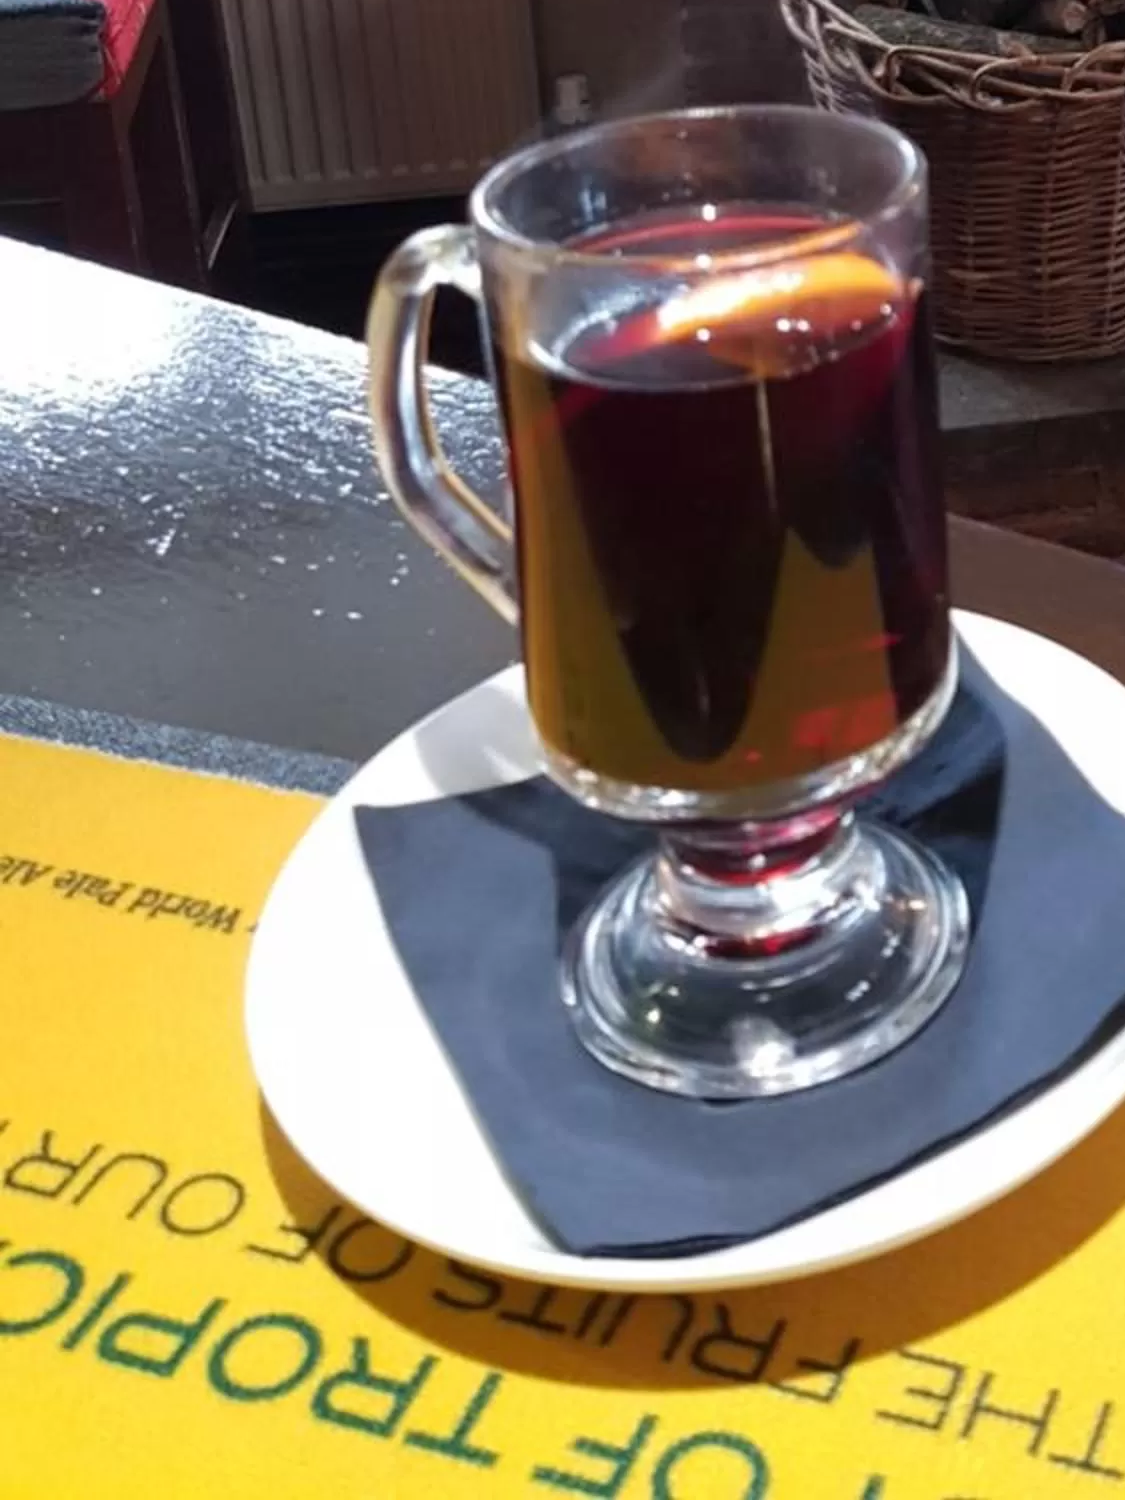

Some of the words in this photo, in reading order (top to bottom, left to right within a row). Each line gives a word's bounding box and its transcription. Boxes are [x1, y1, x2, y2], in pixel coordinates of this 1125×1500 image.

[52, 868, 136, 909] Pale
[124, 887, 242, 935] World
[3, 1129, 247, 1237] OUR
[244, 1205, 416, 1283] OF
[0, 1240, 504, 1467] TROPIC
[431, 1257, 862, 1404] FRUITS
[531, 1414, 771, 1500] OF
[875, 1347, 1125, 1479] THE
